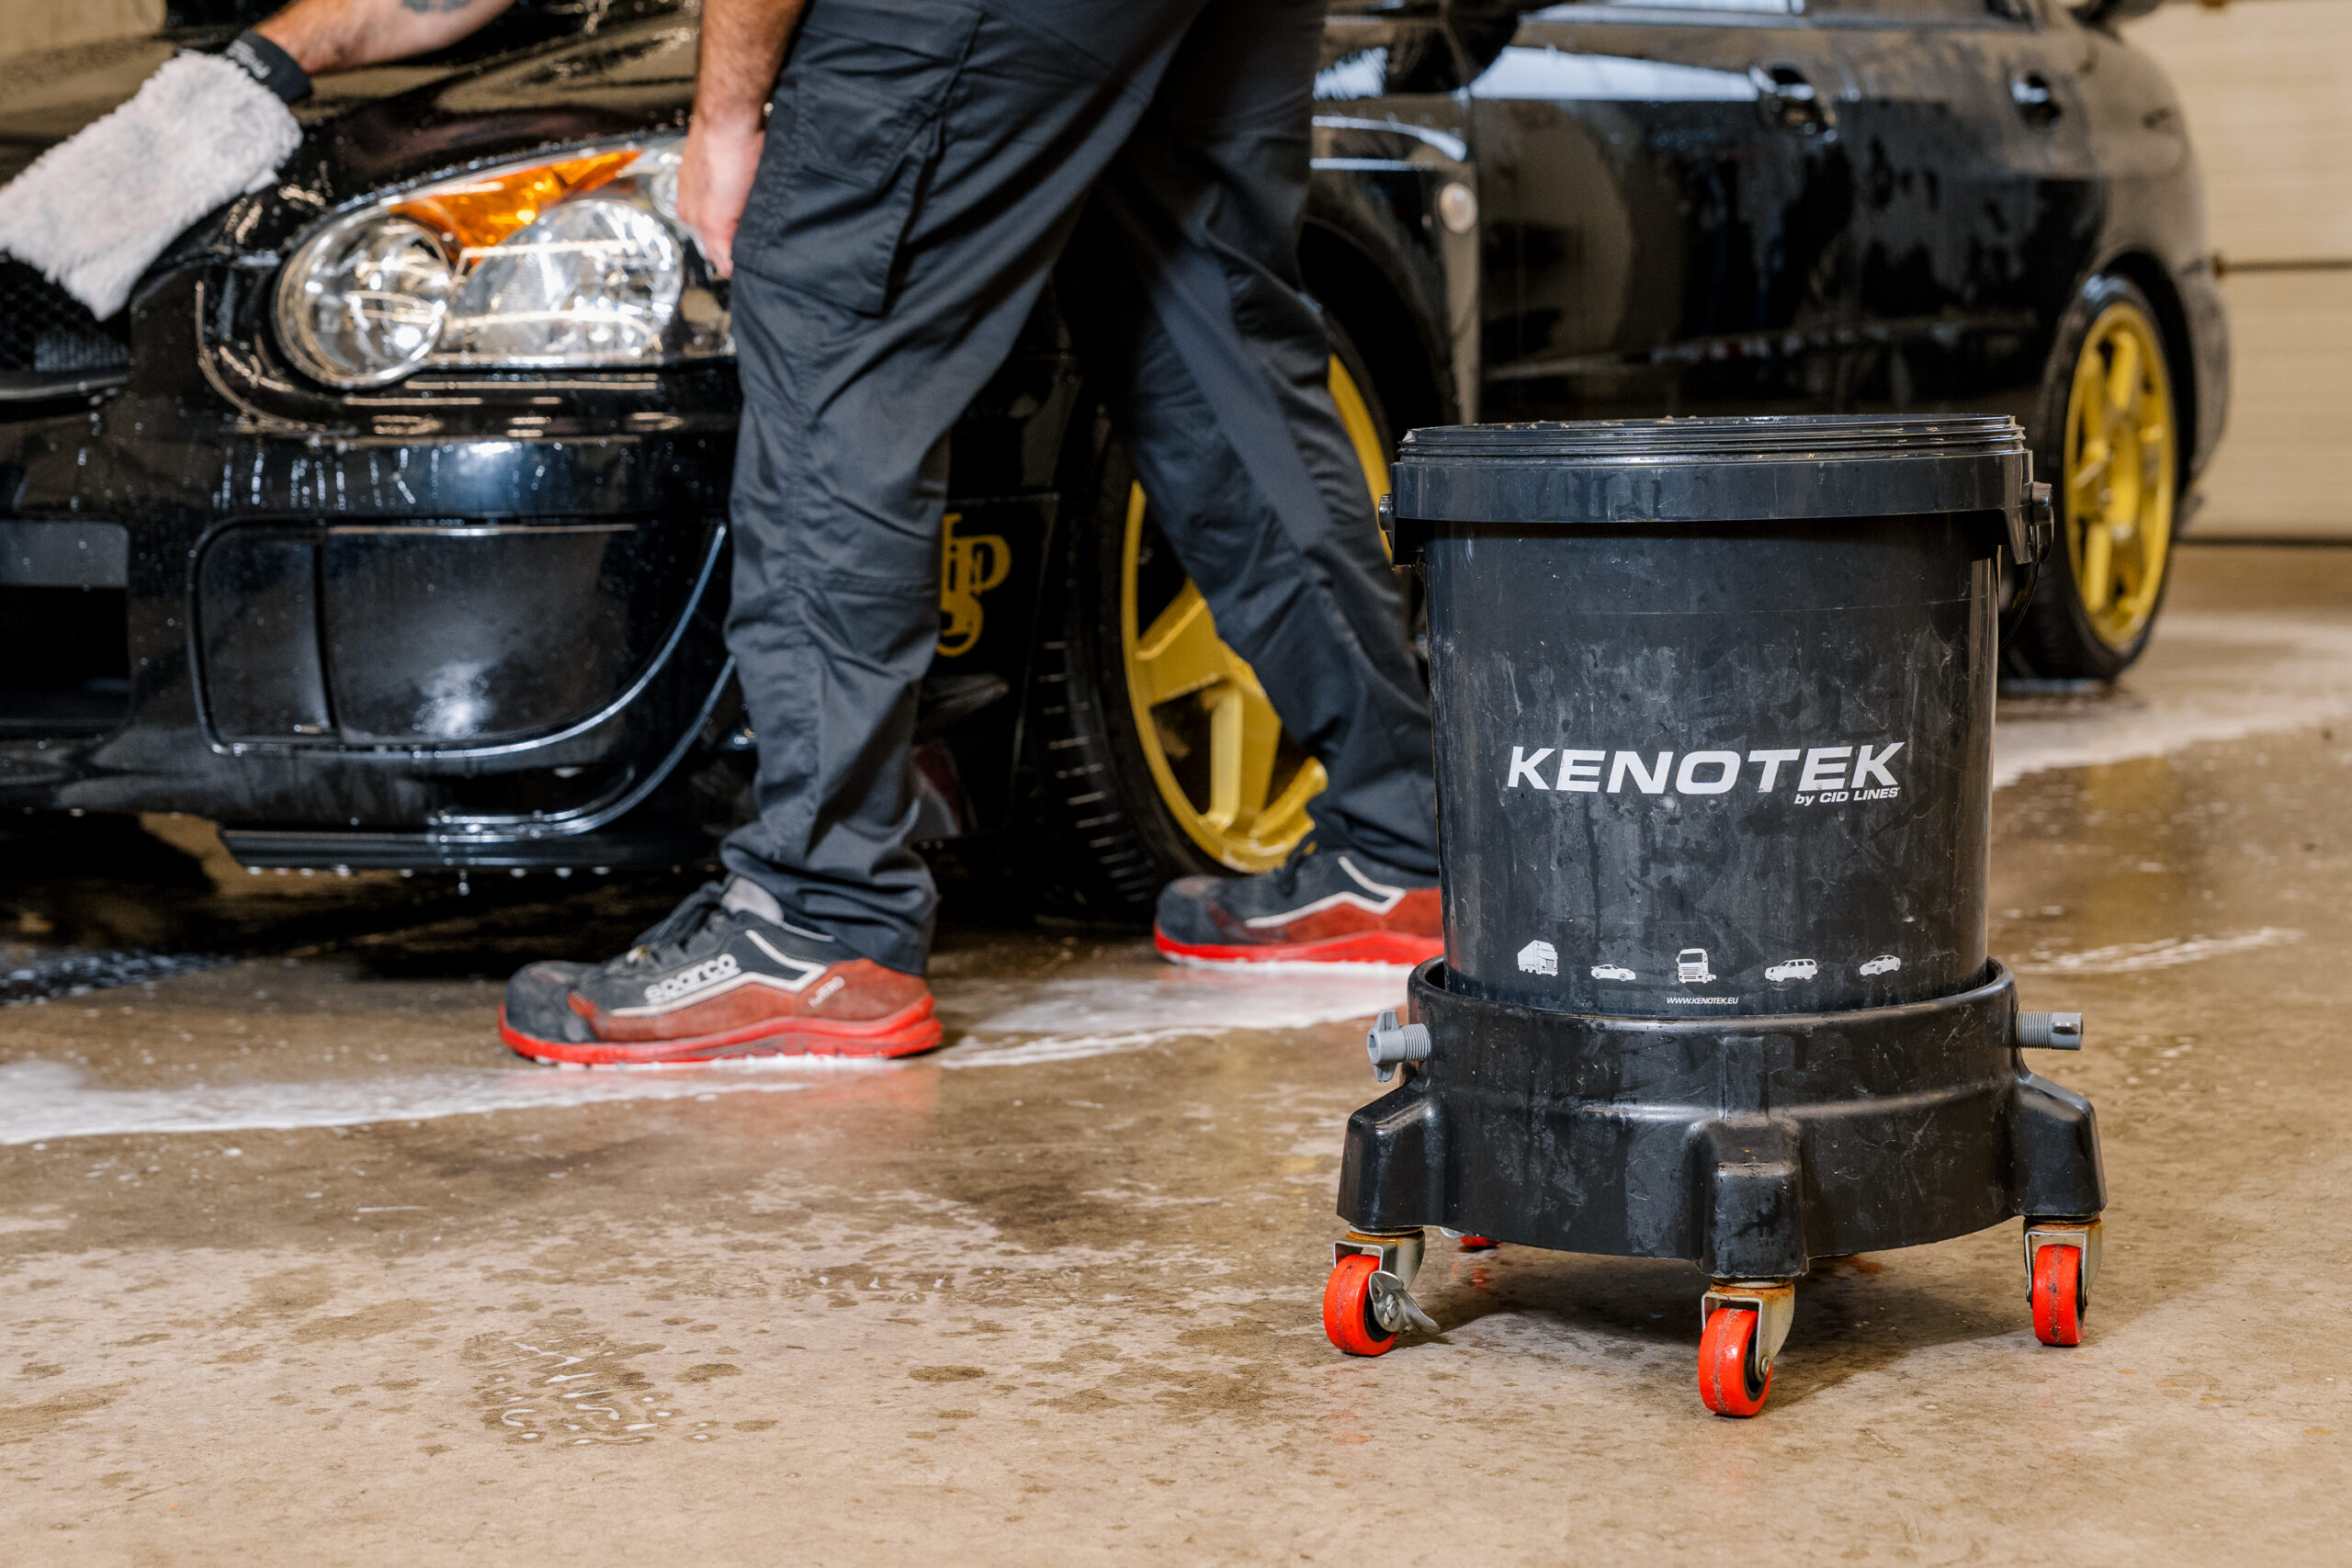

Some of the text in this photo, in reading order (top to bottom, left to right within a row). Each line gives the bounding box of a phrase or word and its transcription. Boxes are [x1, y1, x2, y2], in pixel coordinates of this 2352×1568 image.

[1507, 741, 1905, 795] KENOTEK
[1794, 787, 1899, 807] by CID LINES
[644, 953, 741, 1007] sparco
[1666, 997, 1739, 1005] WWW.KENOTEK.EU
